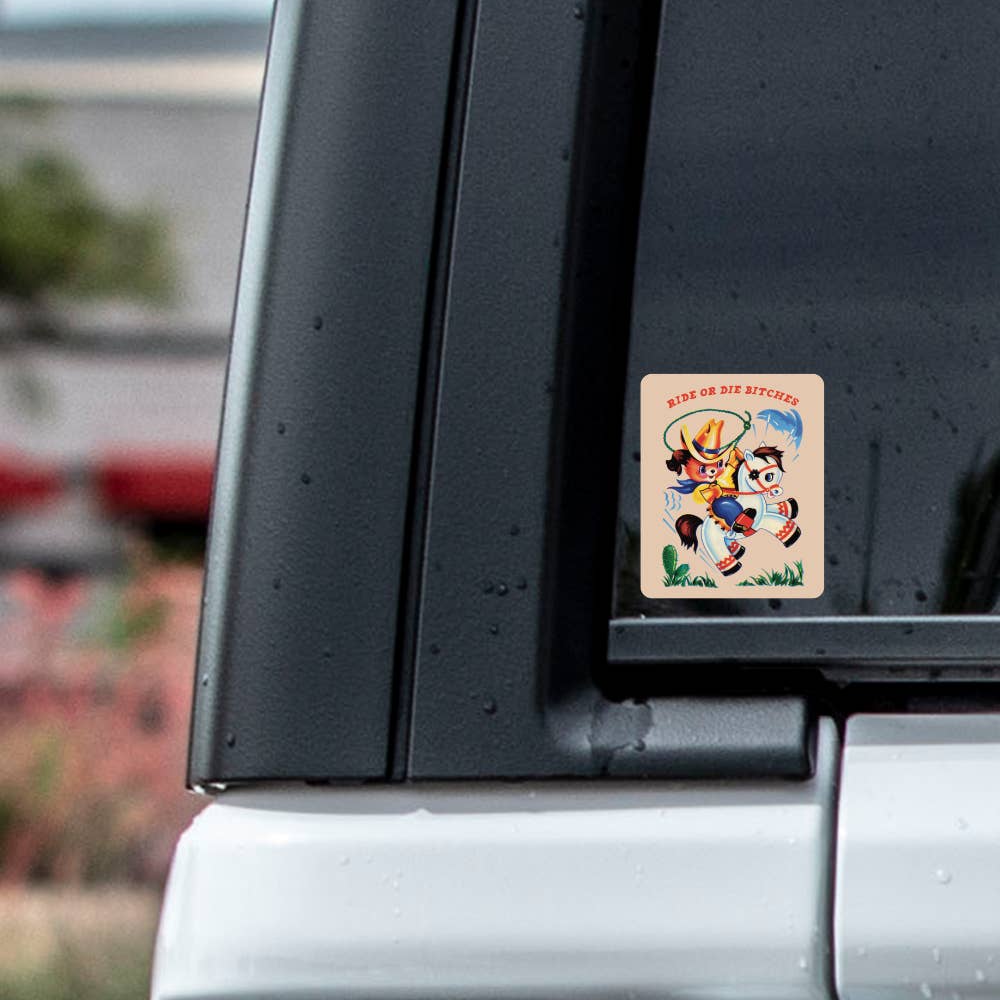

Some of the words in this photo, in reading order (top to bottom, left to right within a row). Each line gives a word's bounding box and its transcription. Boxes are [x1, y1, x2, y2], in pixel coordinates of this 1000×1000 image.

[667, 390, 697, 408] RIDE
[700, 386, 717, 397] OR
[720, 385, 742, 395] DIE
[745, 385, 800, 406] BITCHES
